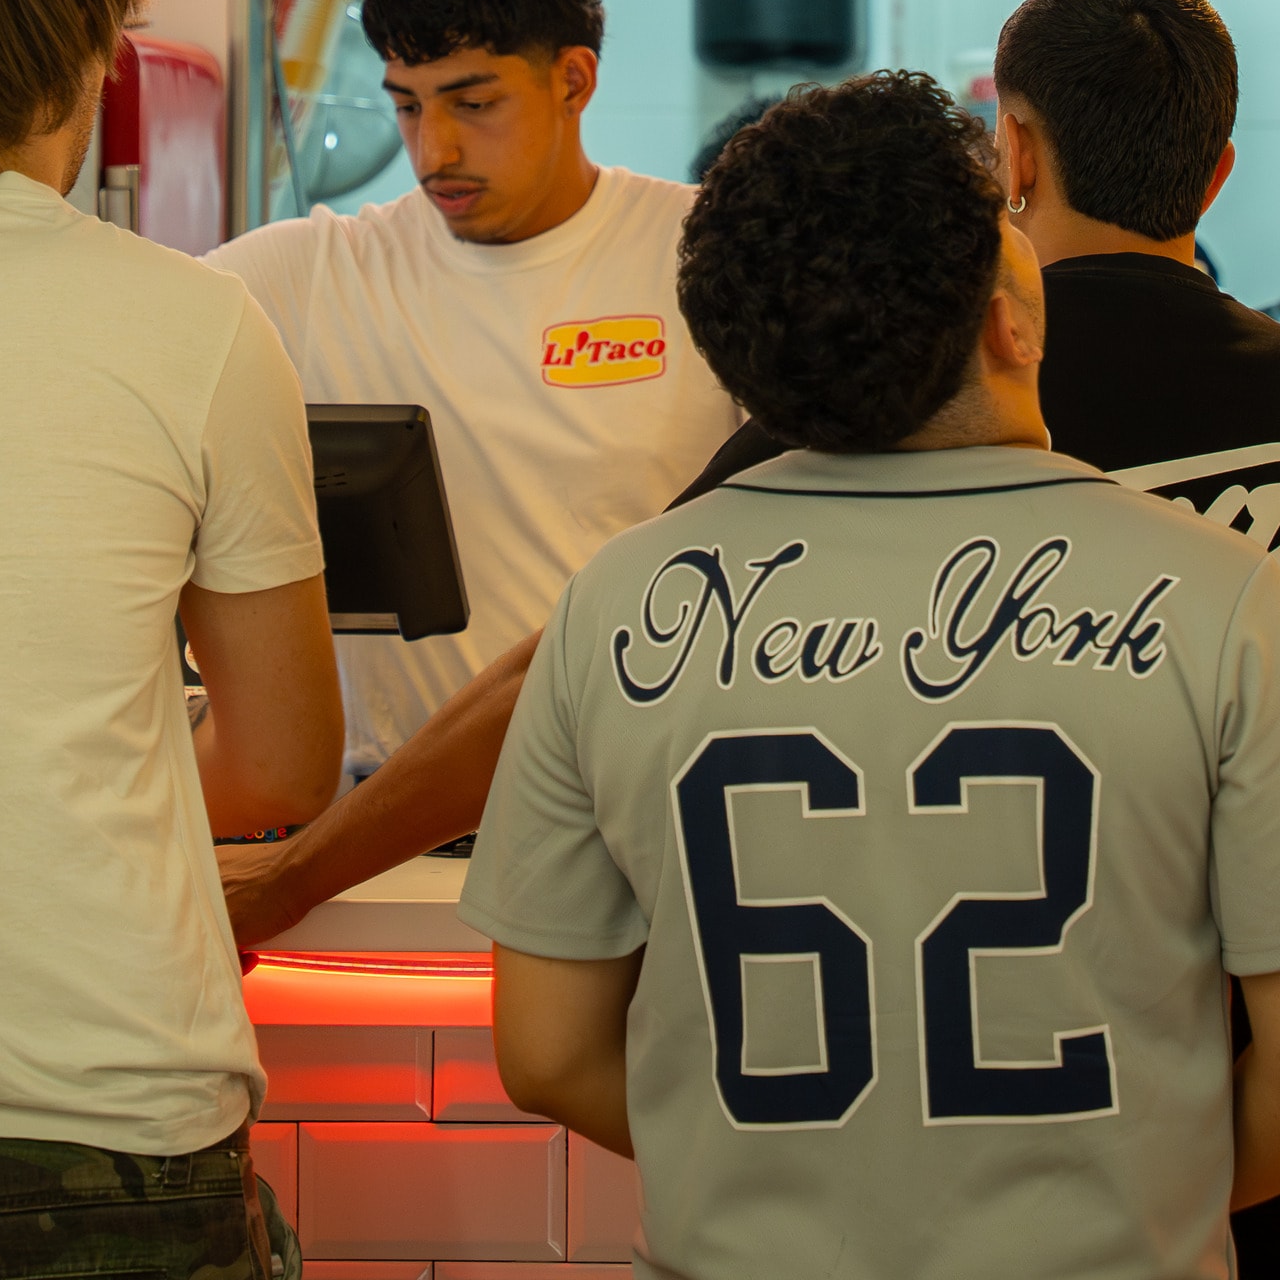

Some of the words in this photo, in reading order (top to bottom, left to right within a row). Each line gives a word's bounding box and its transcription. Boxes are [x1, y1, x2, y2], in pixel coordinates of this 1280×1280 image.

[542, 331, 665, 366] Li'Taco
[611, 539, 882, 707] New
[900, 535, 1180, 704] York
[670, 721, 1120, 1131] 62
